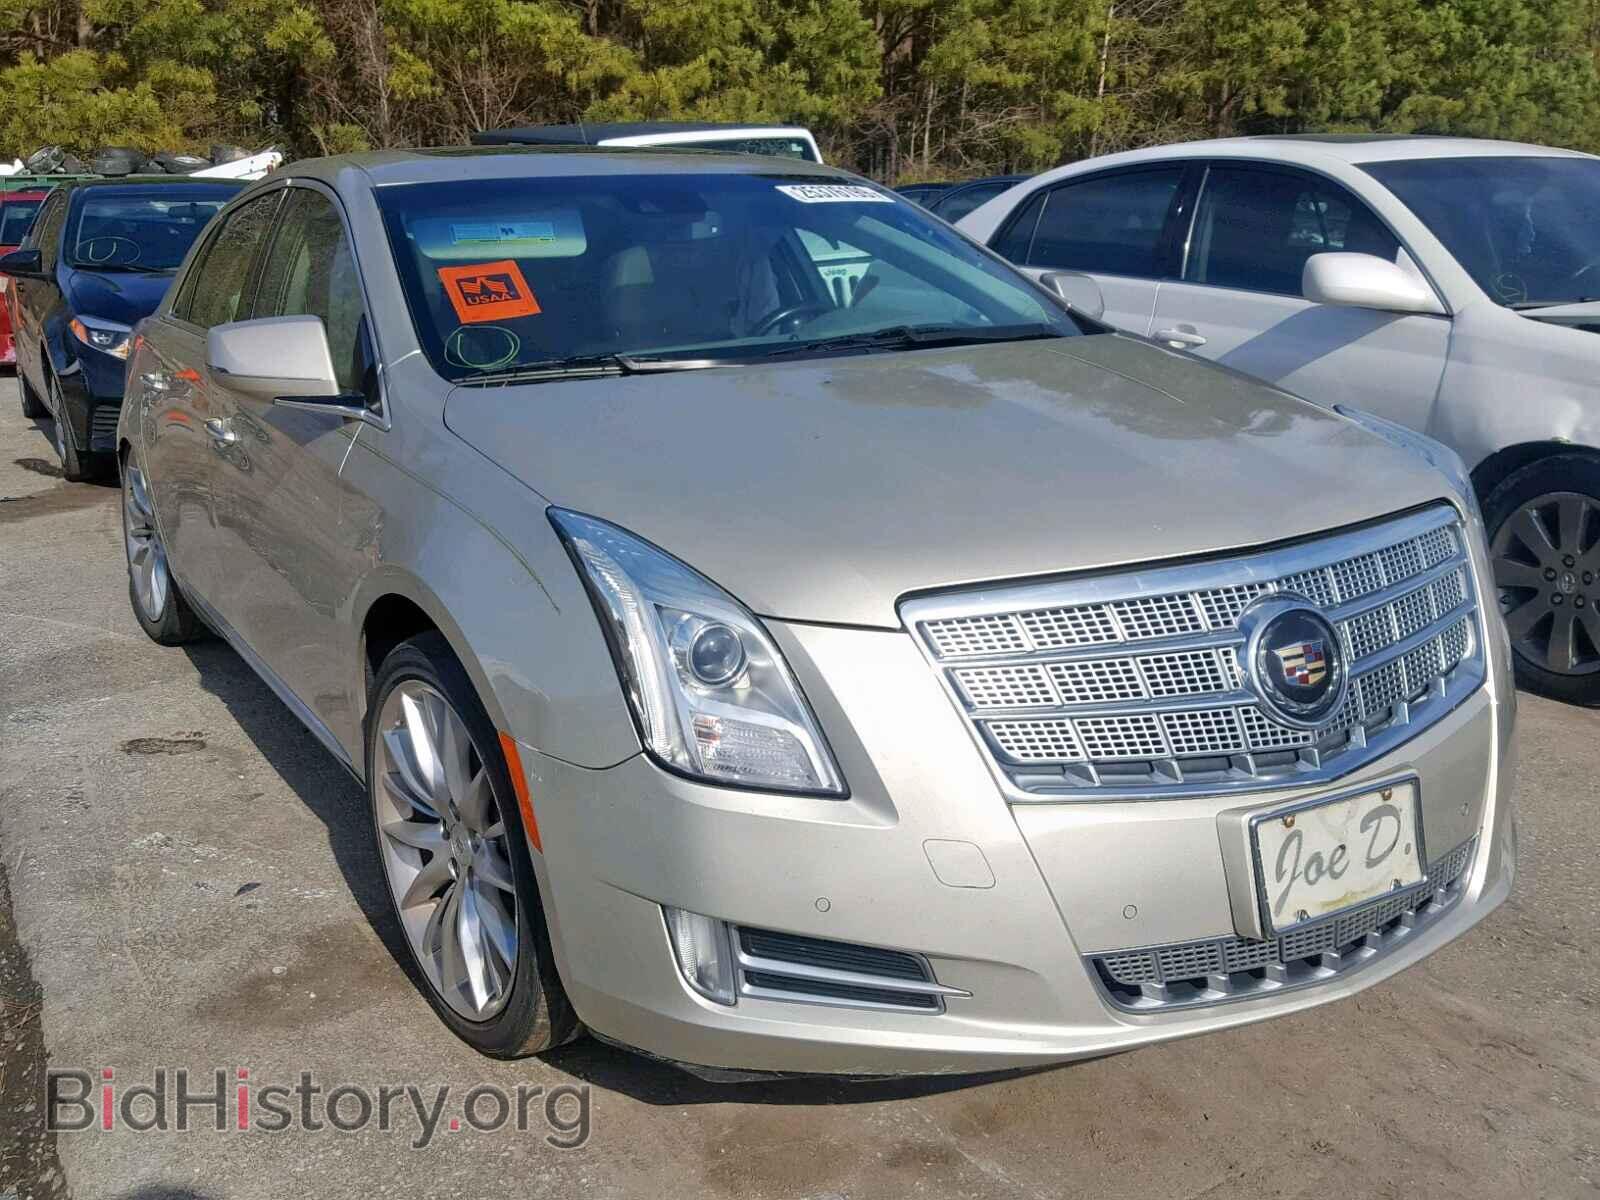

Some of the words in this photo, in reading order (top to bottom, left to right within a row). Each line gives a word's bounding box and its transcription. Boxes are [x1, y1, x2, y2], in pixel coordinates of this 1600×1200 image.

[466, 293, 513, 305] USAA
[1274, 828, 1350, 918] Joe
[1360, 804, 1411, 869] D.
